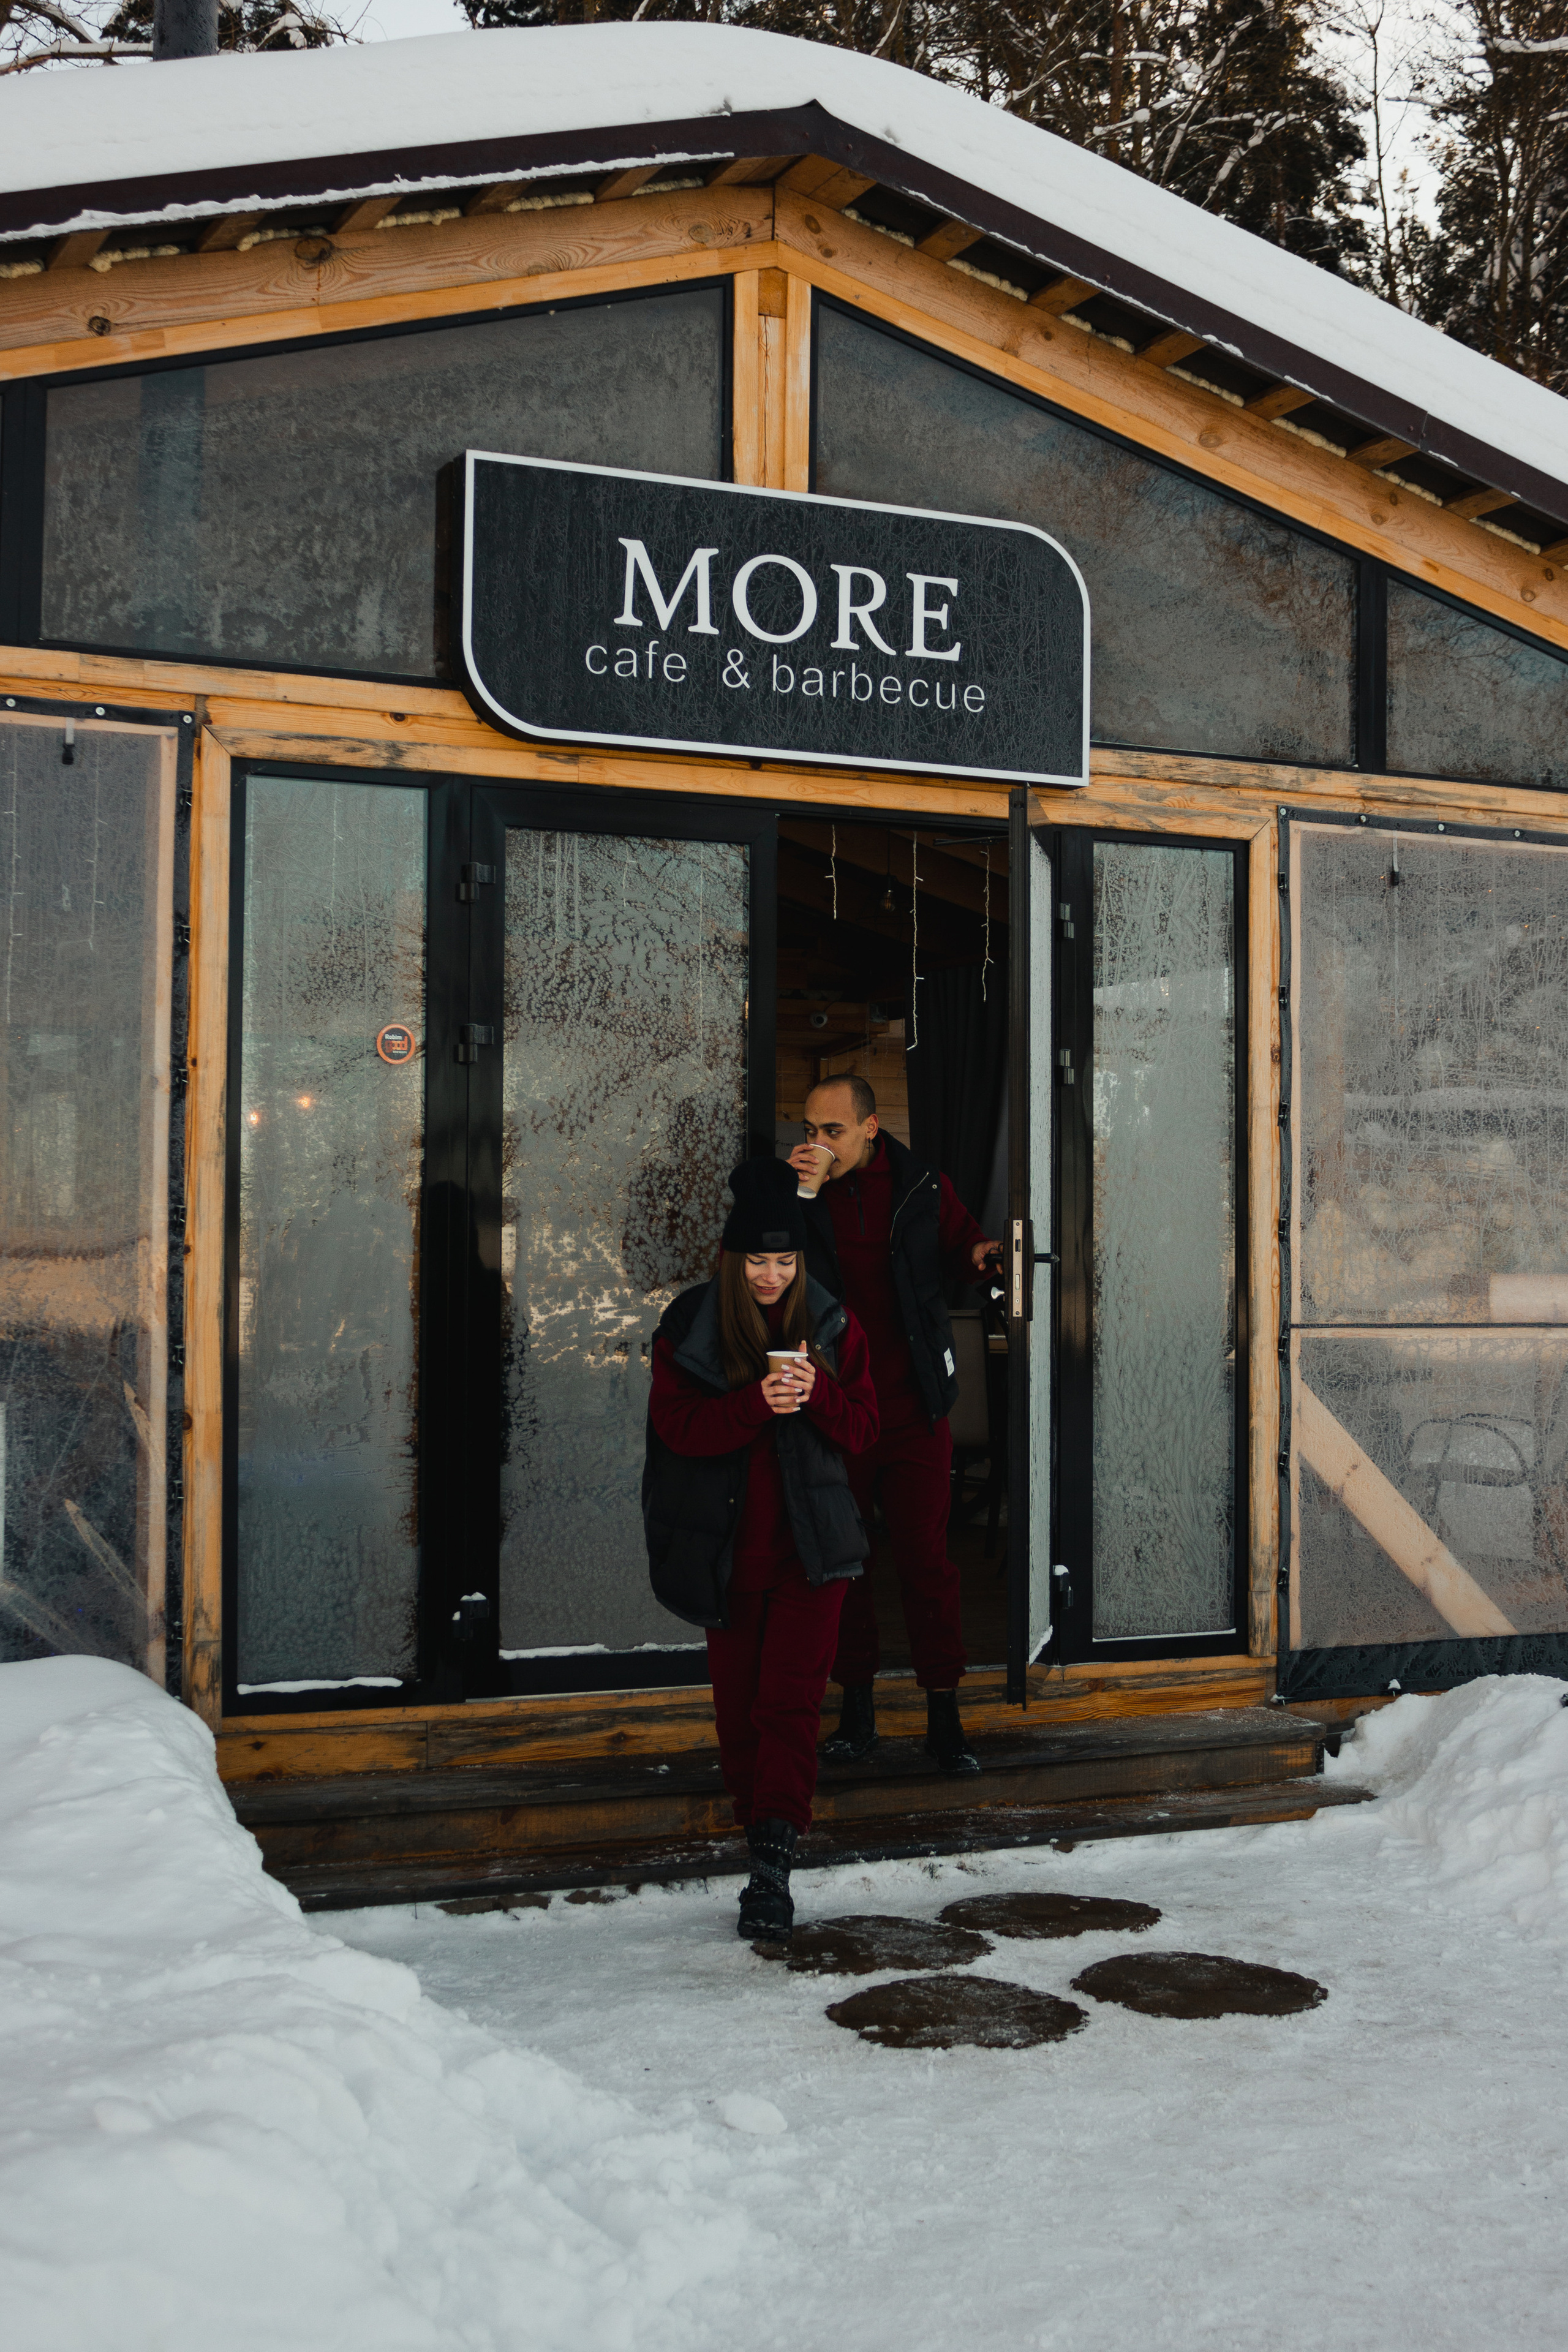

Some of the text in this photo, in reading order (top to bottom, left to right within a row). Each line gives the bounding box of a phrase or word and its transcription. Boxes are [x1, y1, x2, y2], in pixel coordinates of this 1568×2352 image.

[614, 537, 961, 662] MORE
[586, 641, 985, 712] cafe & barbecue
